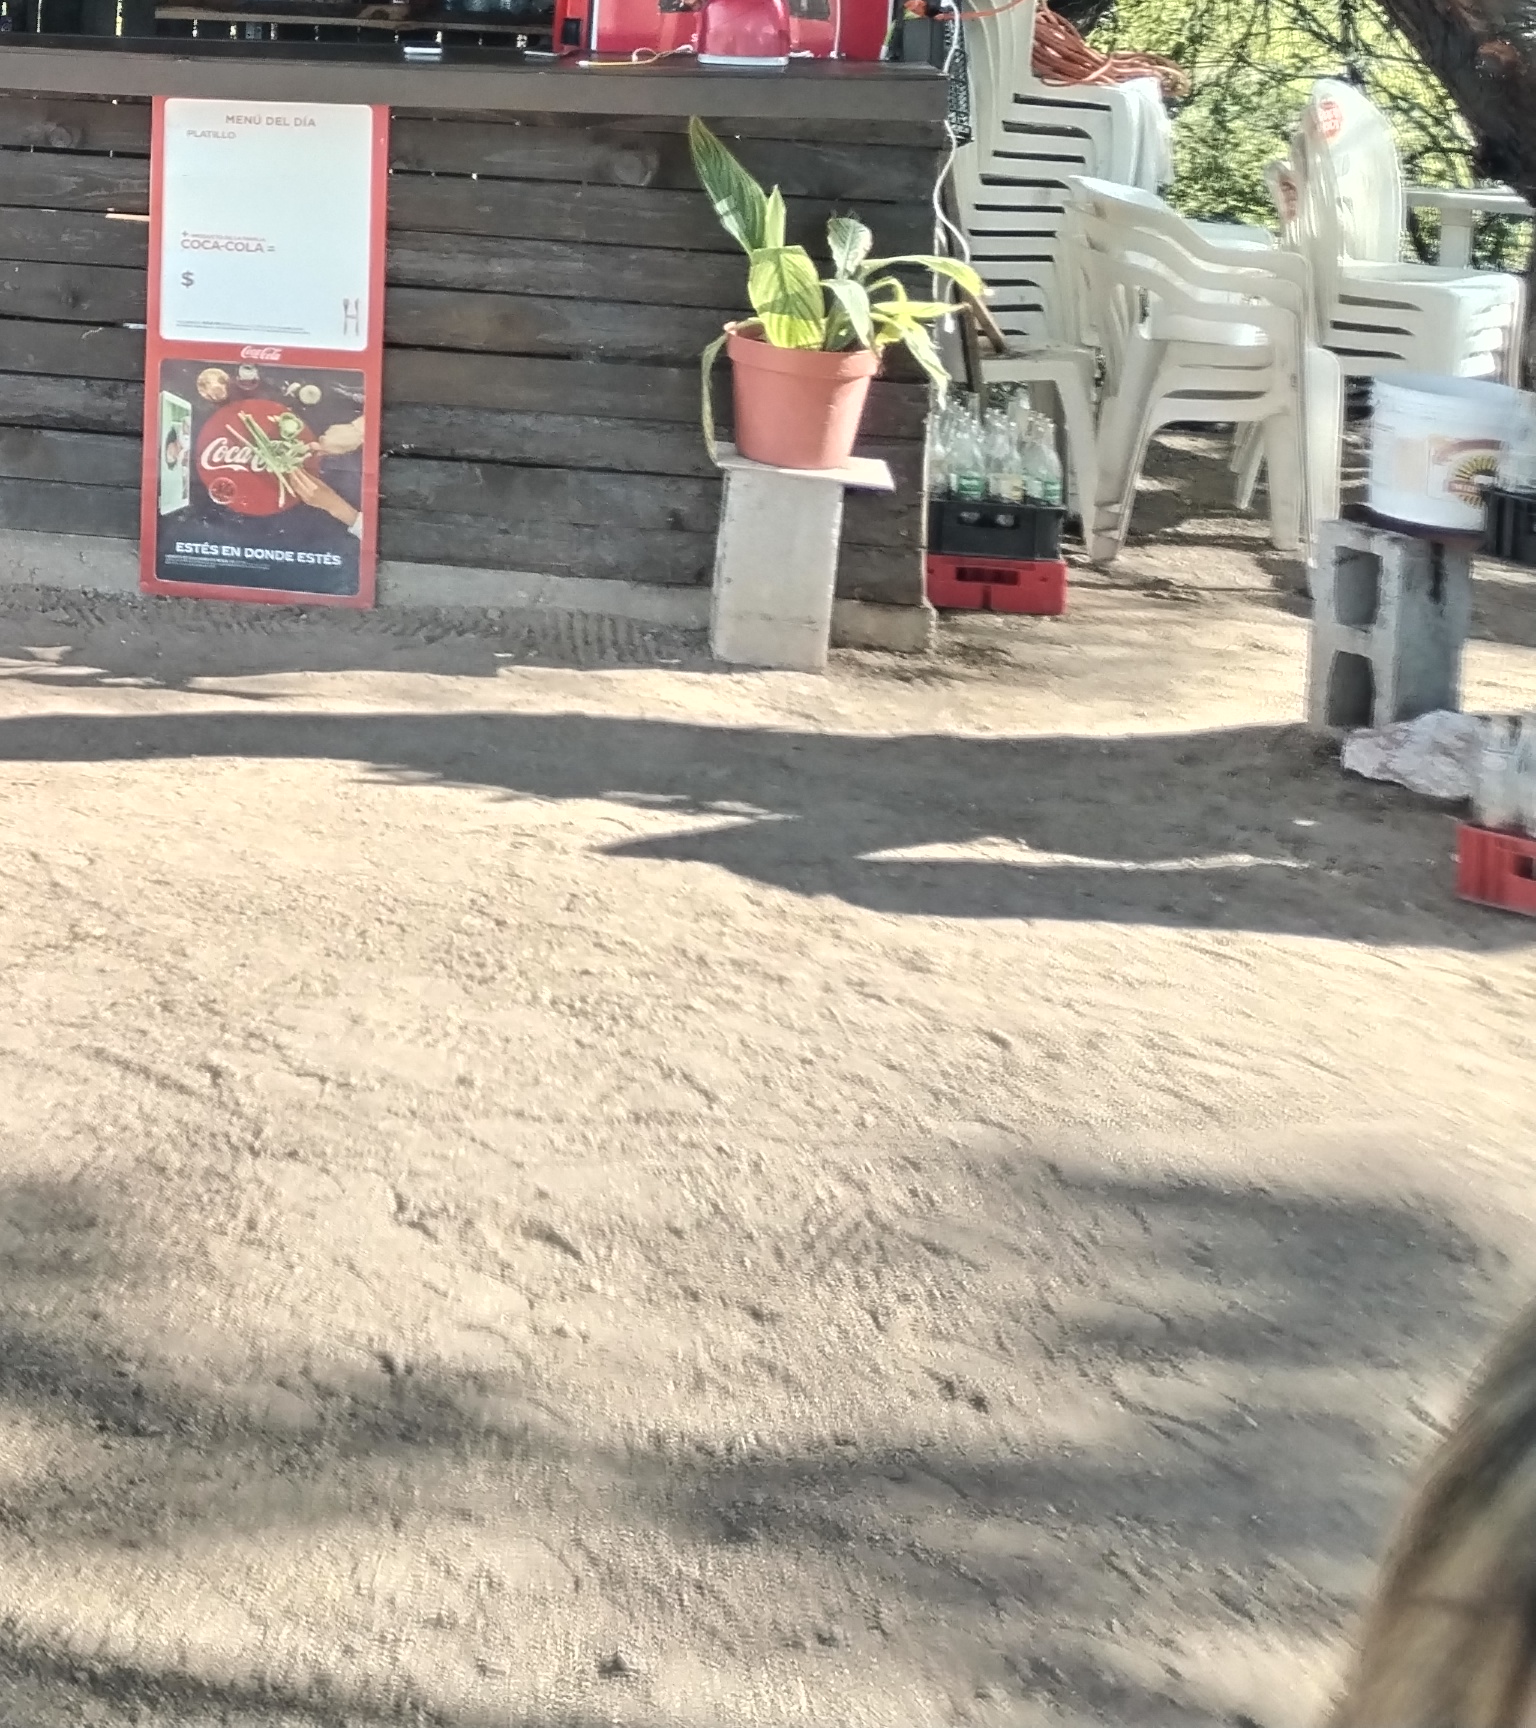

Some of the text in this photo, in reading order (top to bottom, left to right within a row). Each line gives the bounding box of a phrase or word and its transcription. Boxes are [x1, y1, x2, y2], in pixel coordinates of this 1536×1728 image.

[225, 114, 316, 127] MENÚ DEL DÍA
[186, 129, 237, 139] PLATILLO
[181, 238, 265, 253] COCA-COLA
[181, 270, 195, 288] $
[175, 541, 219, 556] ESTÉS
[221, 545, 241, 557] EN
[243, 547, 294, 562] DONDE
[297, 552, 342, 566] ESTÉS
